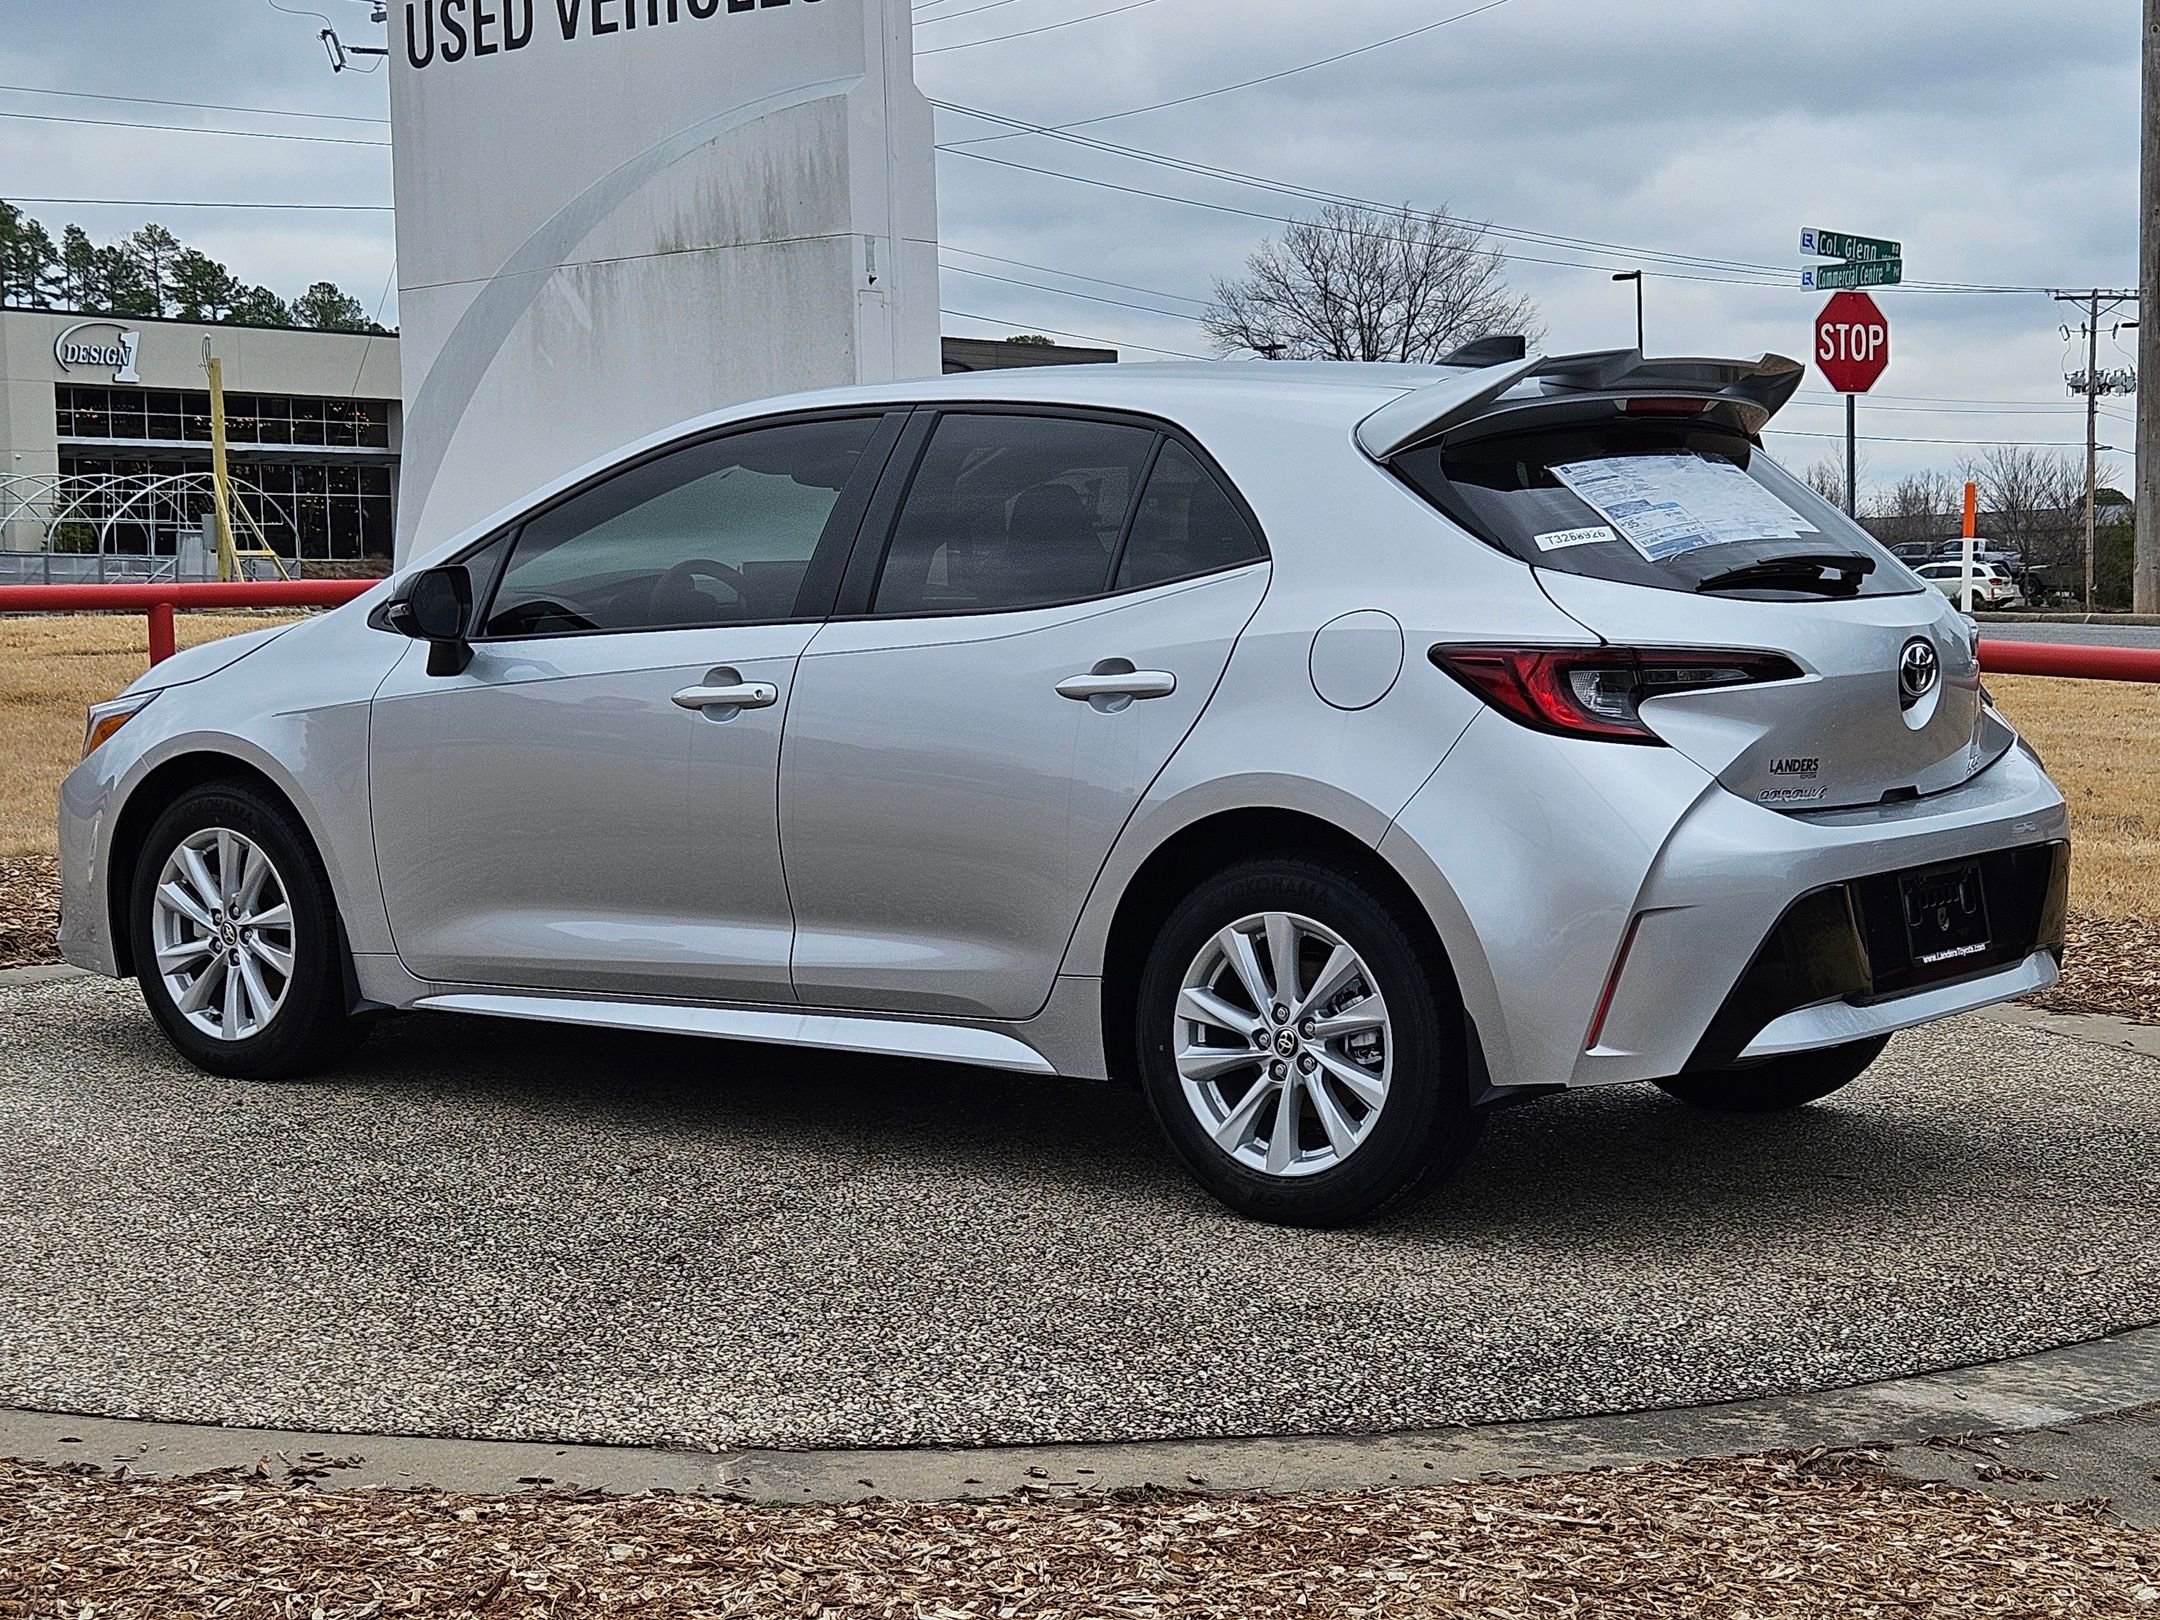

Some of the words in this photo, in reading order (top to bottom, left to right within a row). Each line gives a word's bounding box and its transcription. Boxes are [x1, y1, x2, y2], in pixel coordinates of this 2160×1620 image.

[404, 0, 534, 69] USED
[1820, 234, 1841, 256] Col.
[1845, 238, 1877, 261] Glenn
[1817, 264, 1859, 289] Commercial
[1860, 263, 1884, 286] Centre
[65, 343, 132, 367] DESIGN
[1819, 323, 1884, 361] STOP
[1769, 757, 1820, 775] LANDERS
